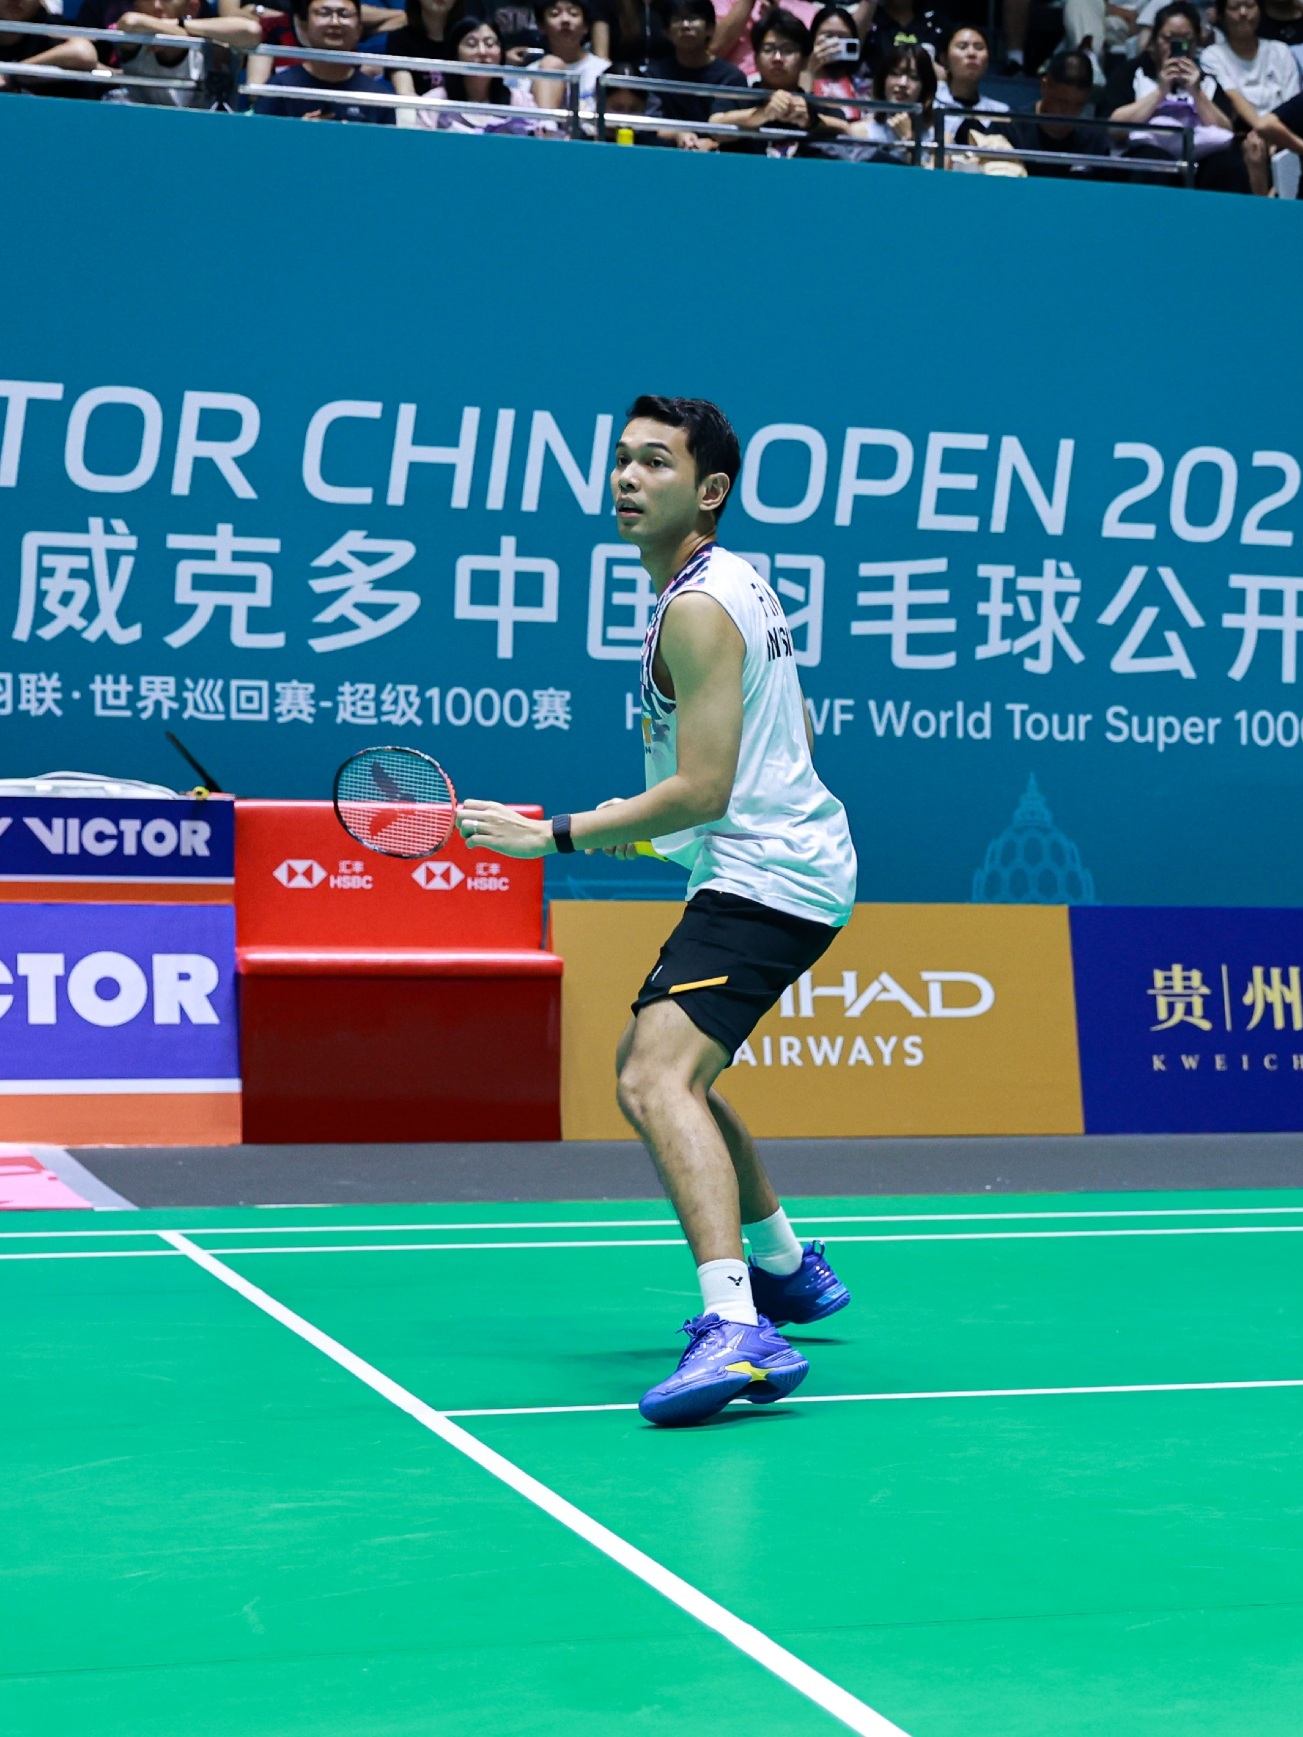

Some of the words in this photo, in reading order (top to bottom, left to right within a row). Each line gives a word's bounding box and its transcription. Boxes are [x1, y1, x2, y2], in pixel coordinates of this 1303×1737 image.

[302, 400, 618, 517] CHIN
[740, 423, 1075, 537] OPEN
[867, 699, 992, 740] World
[1005, 703, 1093, 742] Tour
[1104, 704, 1222, 752] Super
[22, 817, 212, 857] VICTOR
[329, 875, 374, 890] HSBC
[466, 877, 511, 892] HSBC
[0, 951, 221, 1028] TOR
[779, 970, 996, 1019] IHAD
[731, 1035, 924, 1067] AIRWAYS
